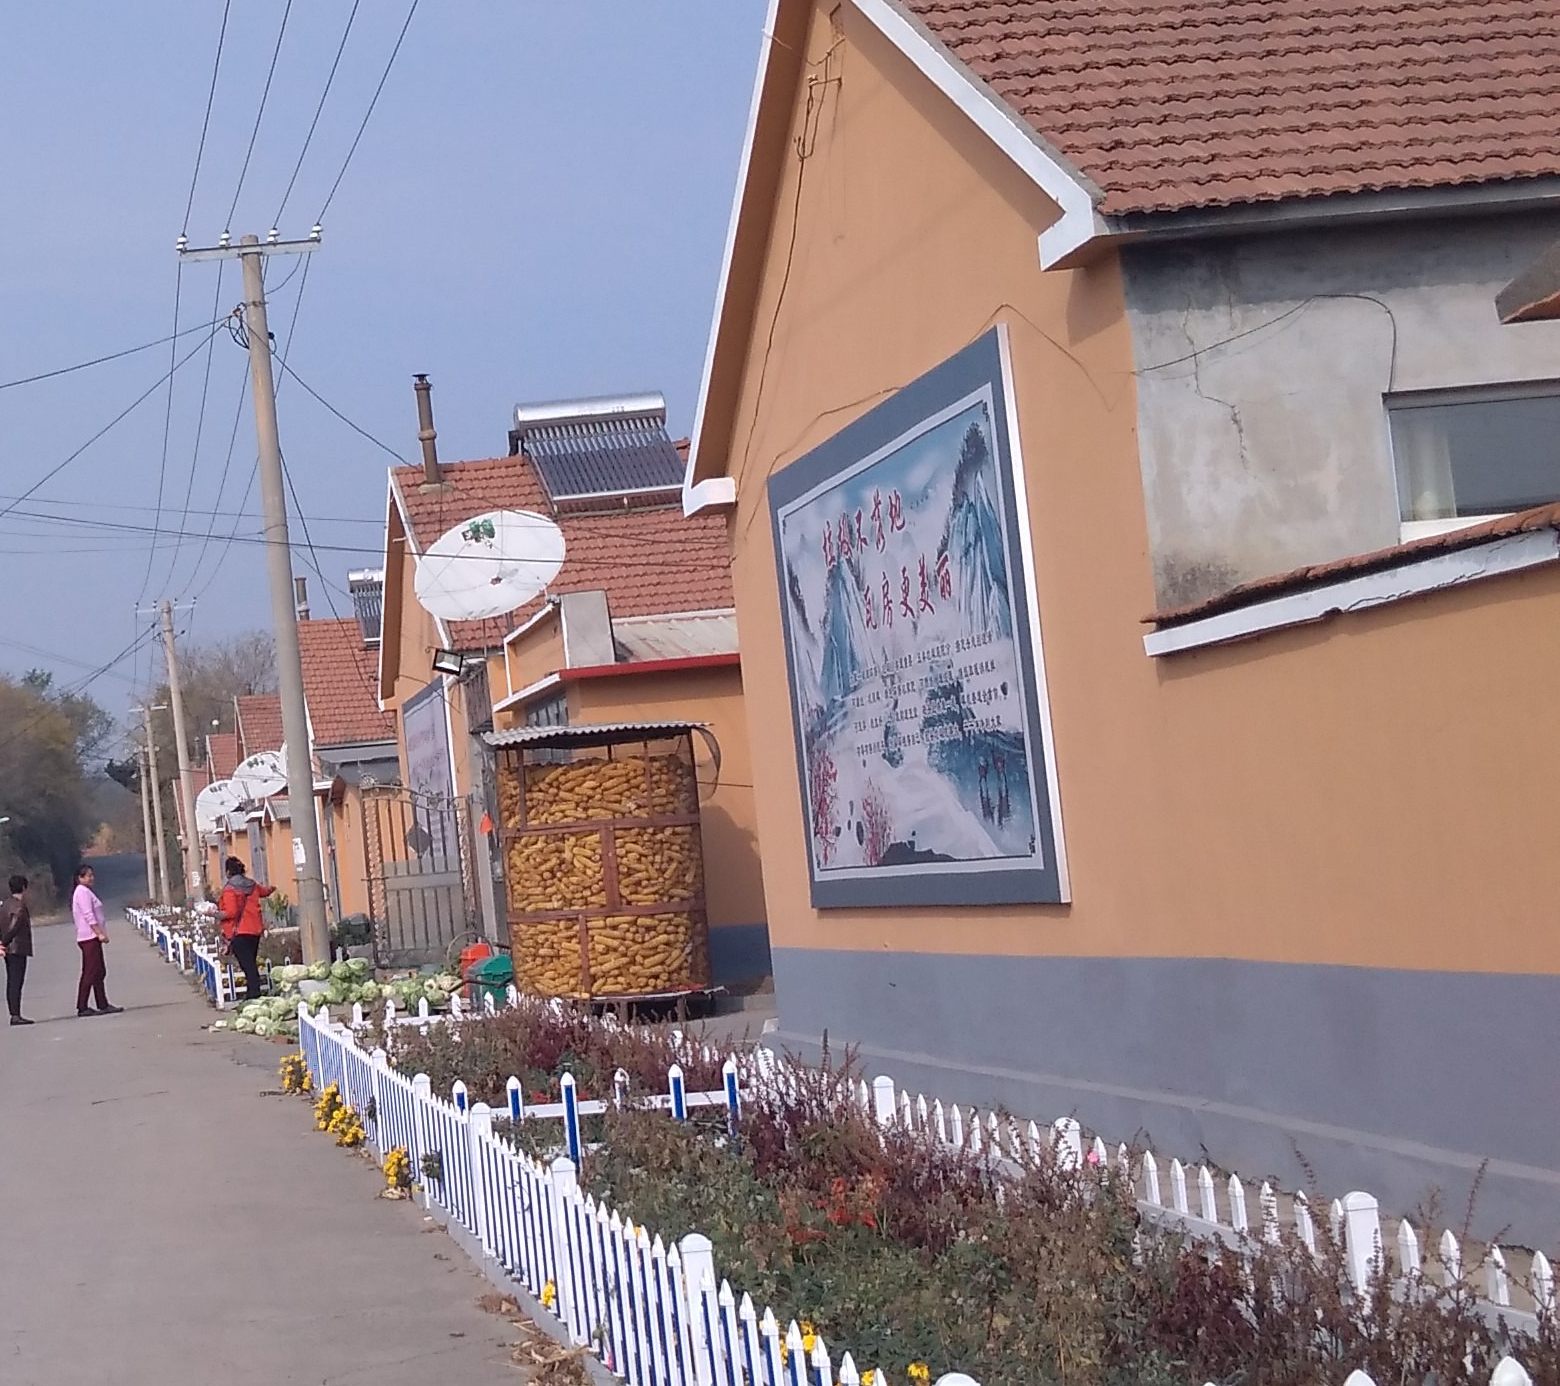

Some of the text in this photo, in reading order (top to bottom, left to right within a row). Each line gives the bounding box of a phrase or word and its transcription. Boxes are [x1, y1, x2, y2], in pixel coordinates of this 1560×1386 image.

[822, 488, 906, 568] 垃圾不落地
[864, 552, 953, 630] 瓦房更美丽
